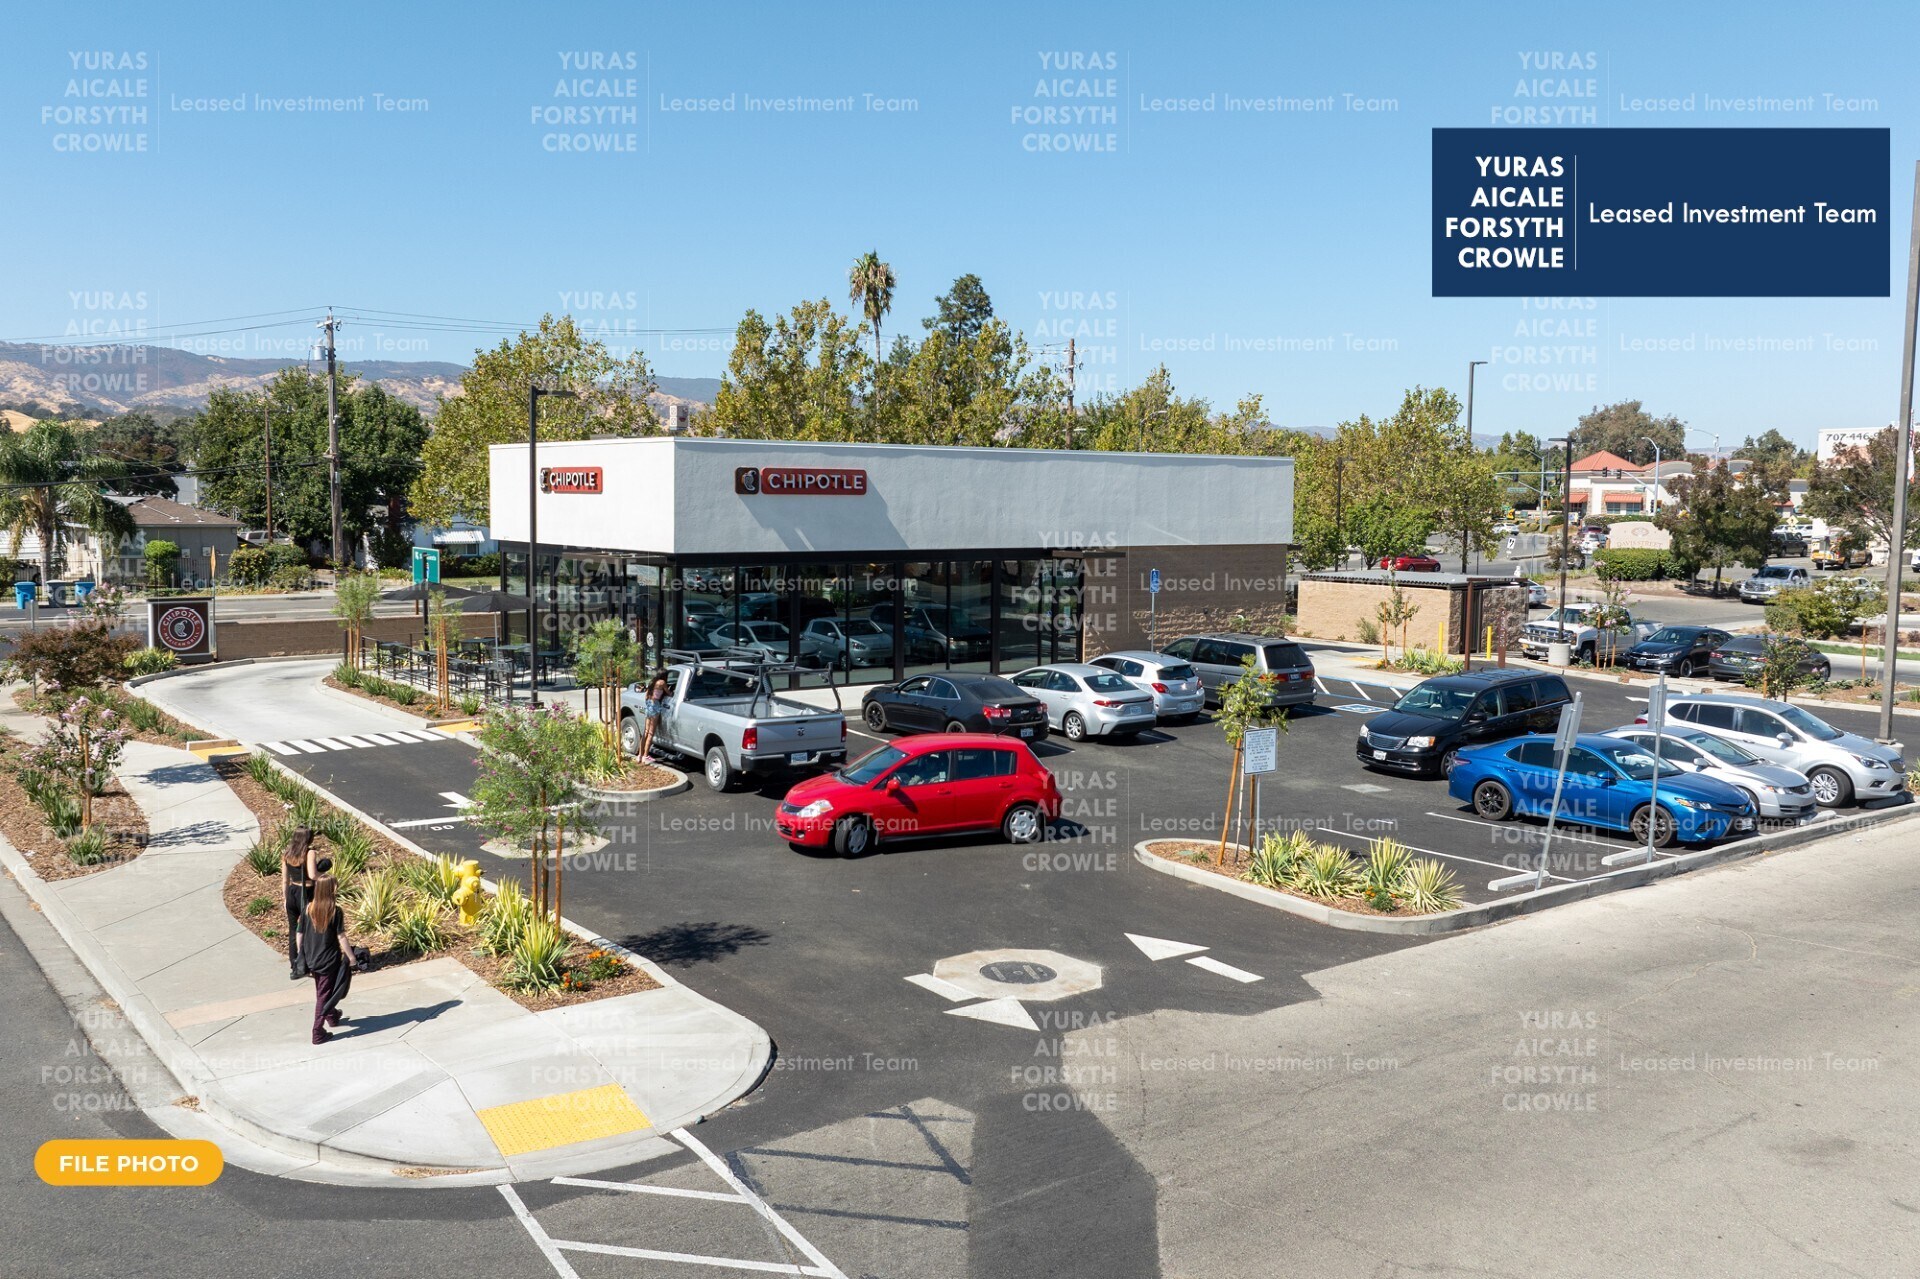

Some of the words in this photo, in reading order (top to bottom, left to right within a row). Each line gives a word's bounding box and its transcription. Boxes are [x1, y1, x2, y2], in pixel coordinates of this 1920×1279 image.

[550, 472, 596, 486] CHIPOTLE
[768, 473, 864, 489] CHIPOTLE
[162, 610, 200, 626] CHIPOTLE
